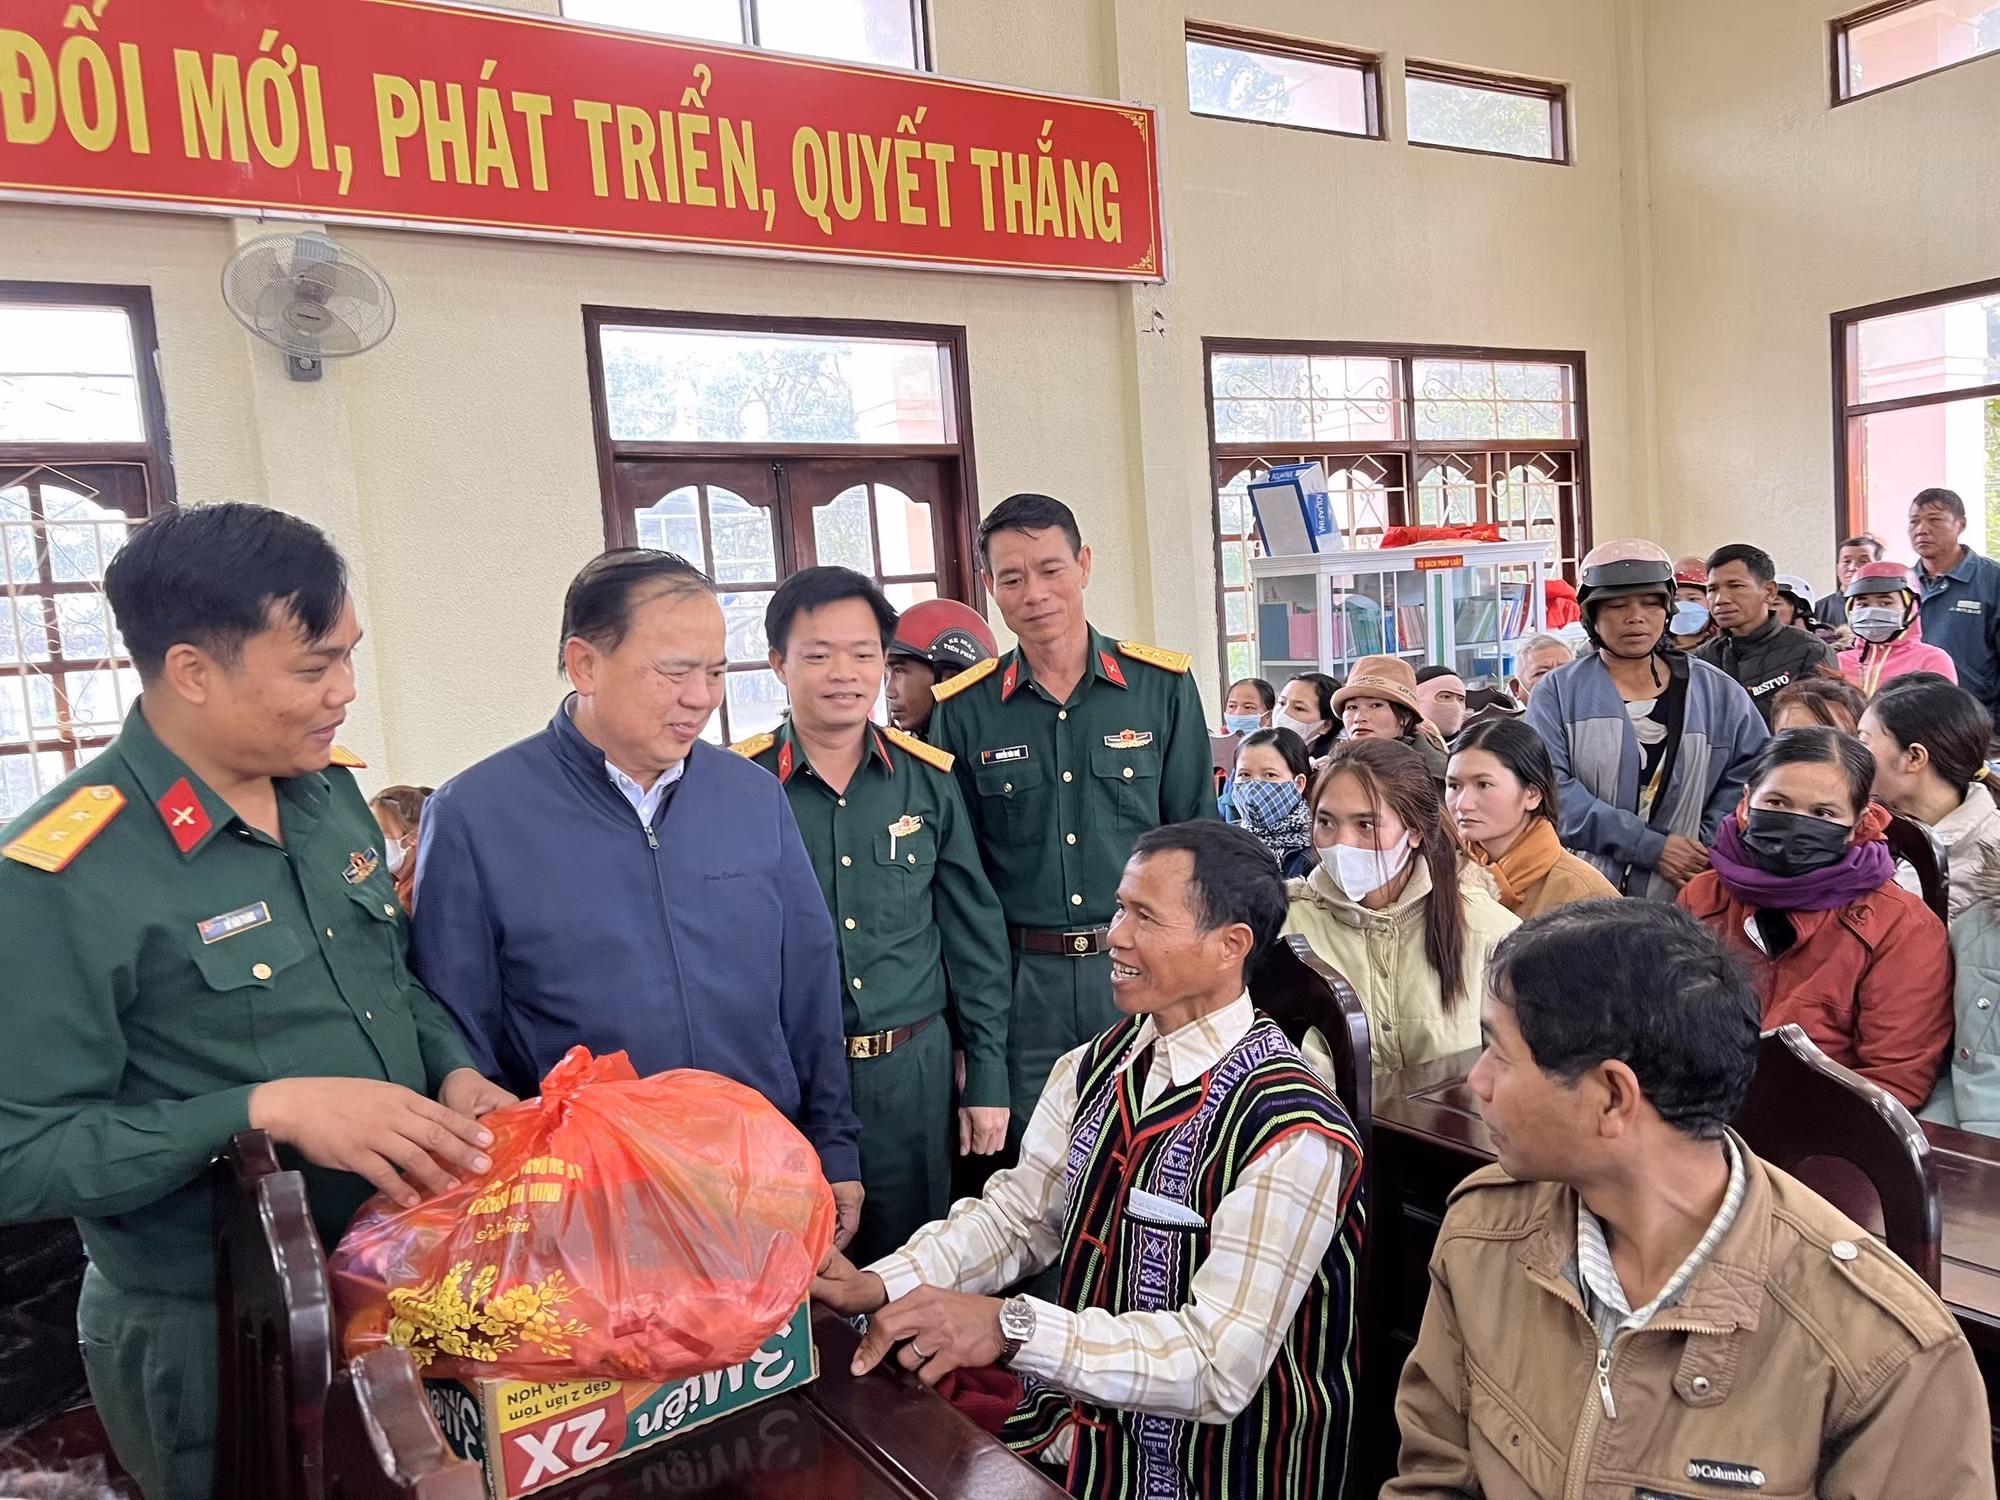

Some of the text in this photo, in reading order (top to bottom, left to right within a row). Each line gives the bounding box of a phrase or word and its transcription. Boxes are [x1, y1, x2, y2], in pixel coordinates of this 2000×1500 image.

[0, 0, 1122, 244] ĐỔI MỚI, PHÁT TRIỂN, QUYẾT THẮNG
[507, 1384, 543, 1406] HƠN
[571, 1391, 581, 1402] 2
[583, 1381, 611, 1397] Gấp
[635, 1363, 744, 1437] Miền
[509, 1403, 542, 1421] Tôm
[513, 1407, 610, 1489] 2X
[1700, 1464, 1754, 1485] Columbi
